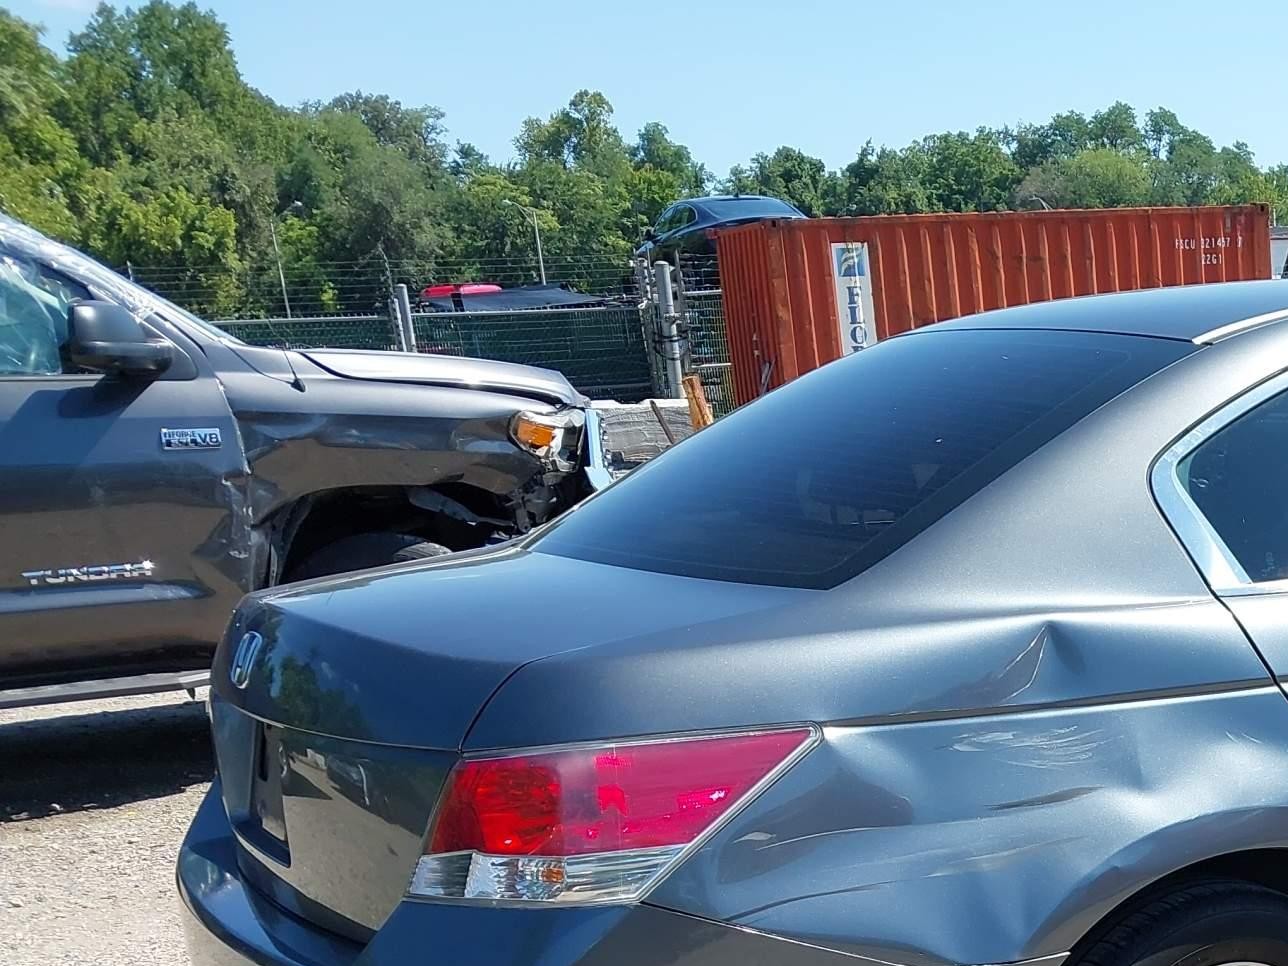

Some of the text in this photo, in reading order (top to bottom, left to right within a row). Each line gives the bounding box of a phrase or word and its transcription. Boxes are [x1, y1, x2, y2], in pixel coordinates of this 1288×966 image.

[846, 286, 868, 352] FLO
[197, 432, 219, 446] V8
[21, 559, 154, 585] TUNDRA
